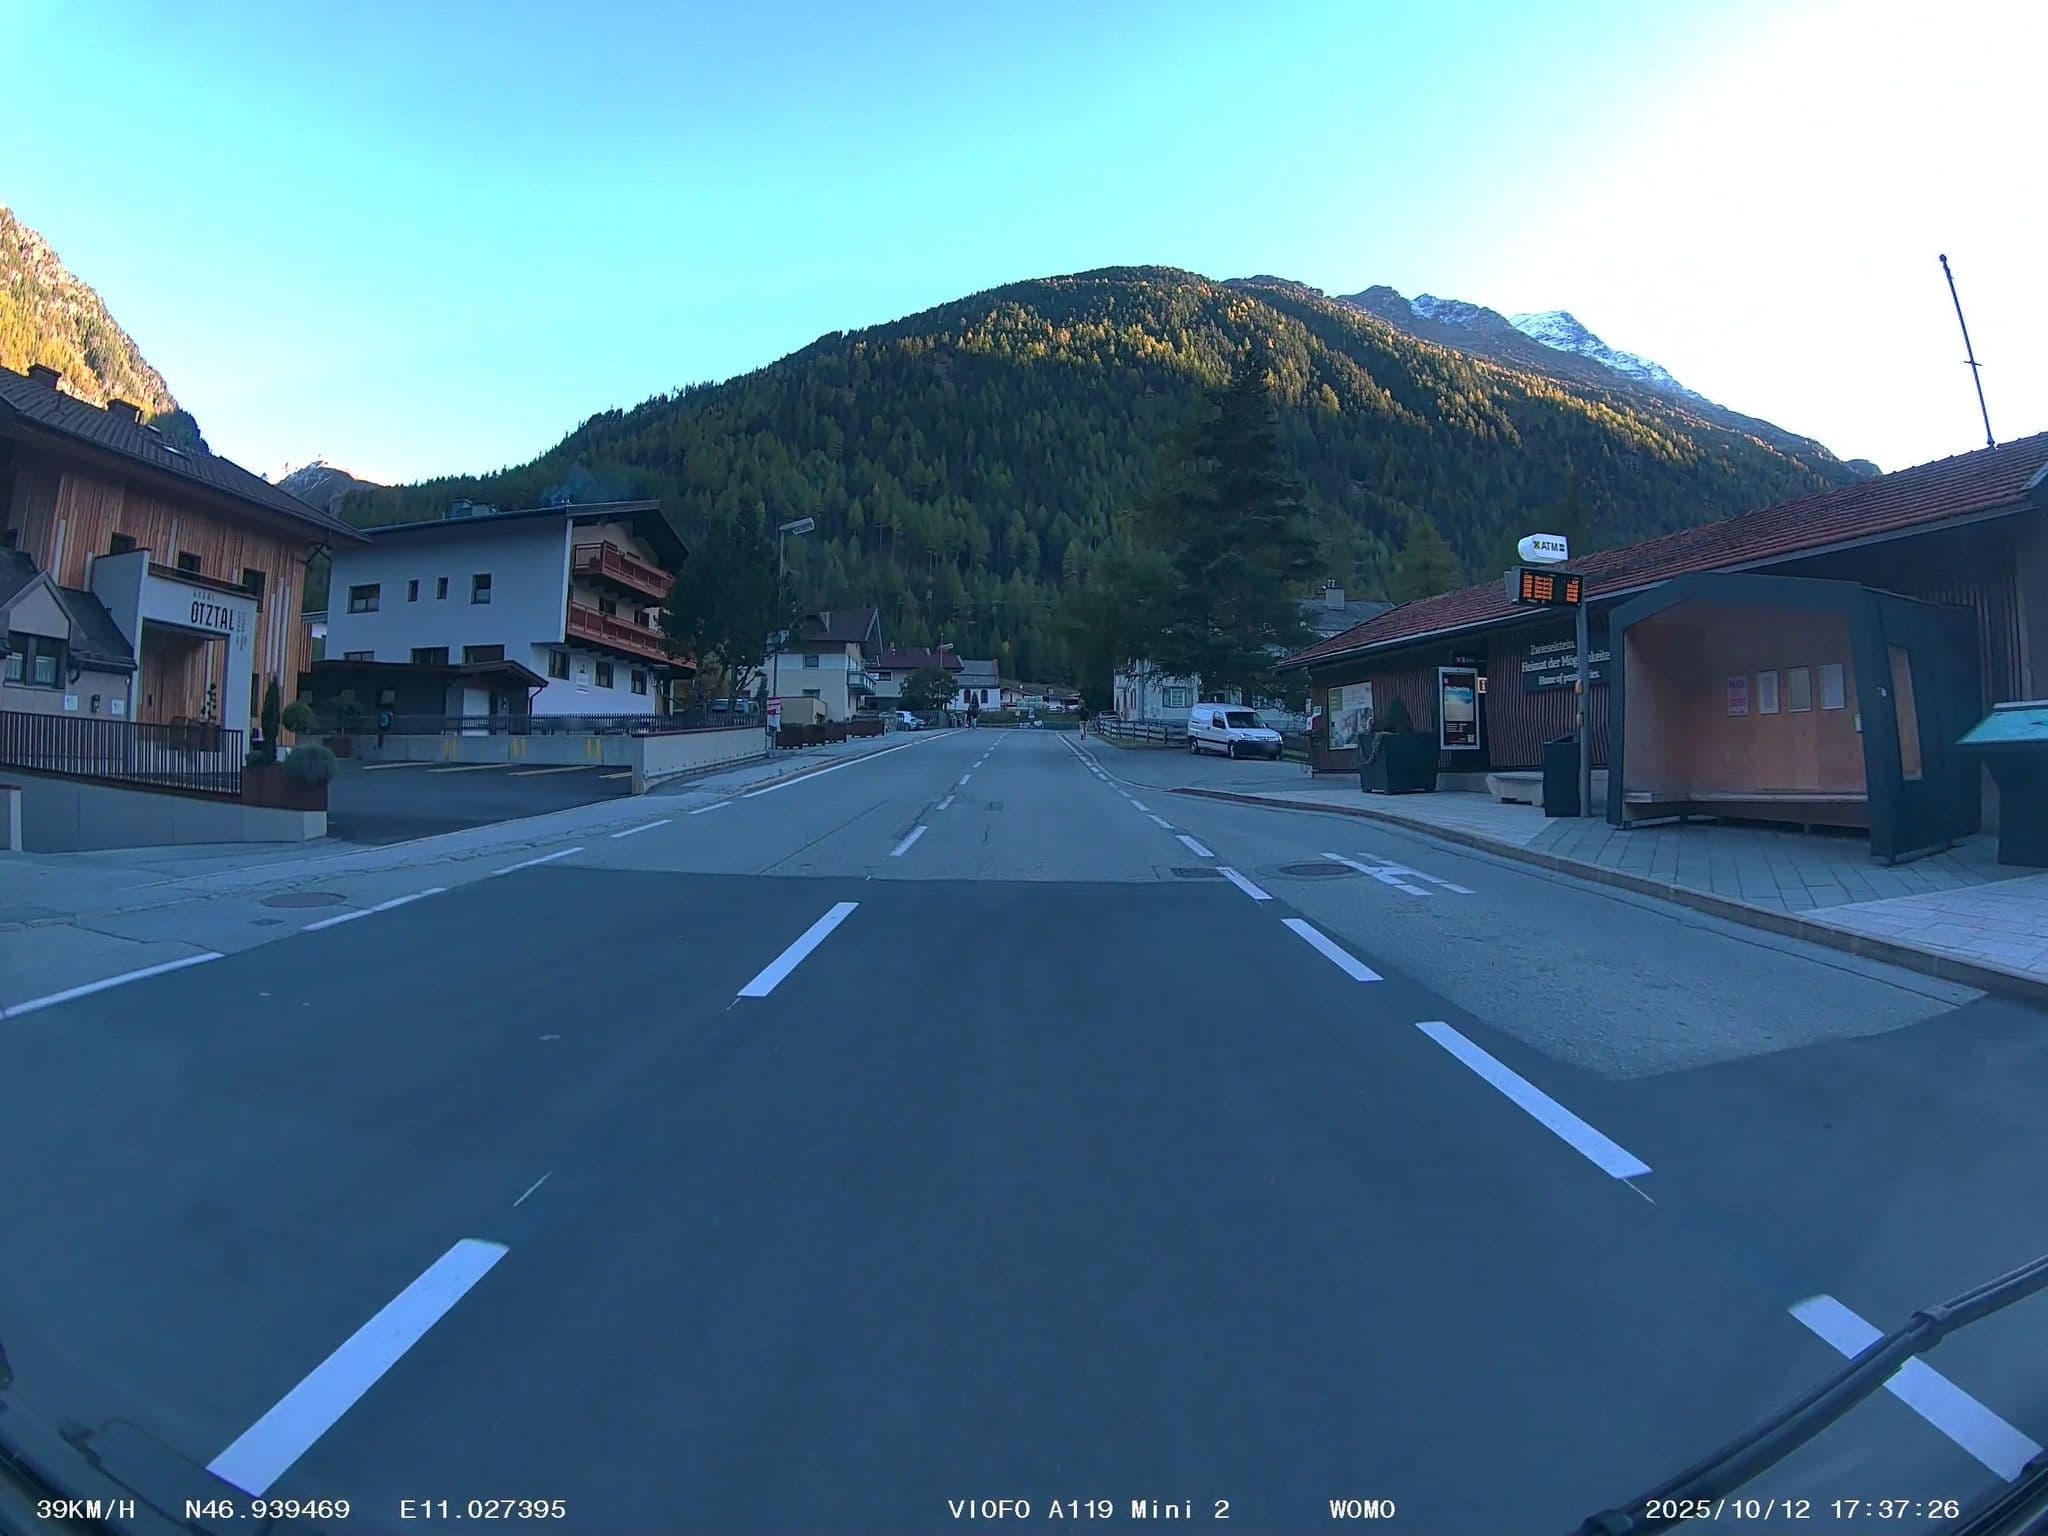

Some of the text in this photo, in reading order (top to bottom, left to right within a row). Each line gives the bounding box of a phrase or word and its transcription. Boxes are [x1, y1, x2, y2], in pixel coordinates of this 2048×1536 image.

[1542, 541, 1559, 552] ATM
[1522, 660, 1549, 673] Heimat
[1548, 657, 1561, 668] der
